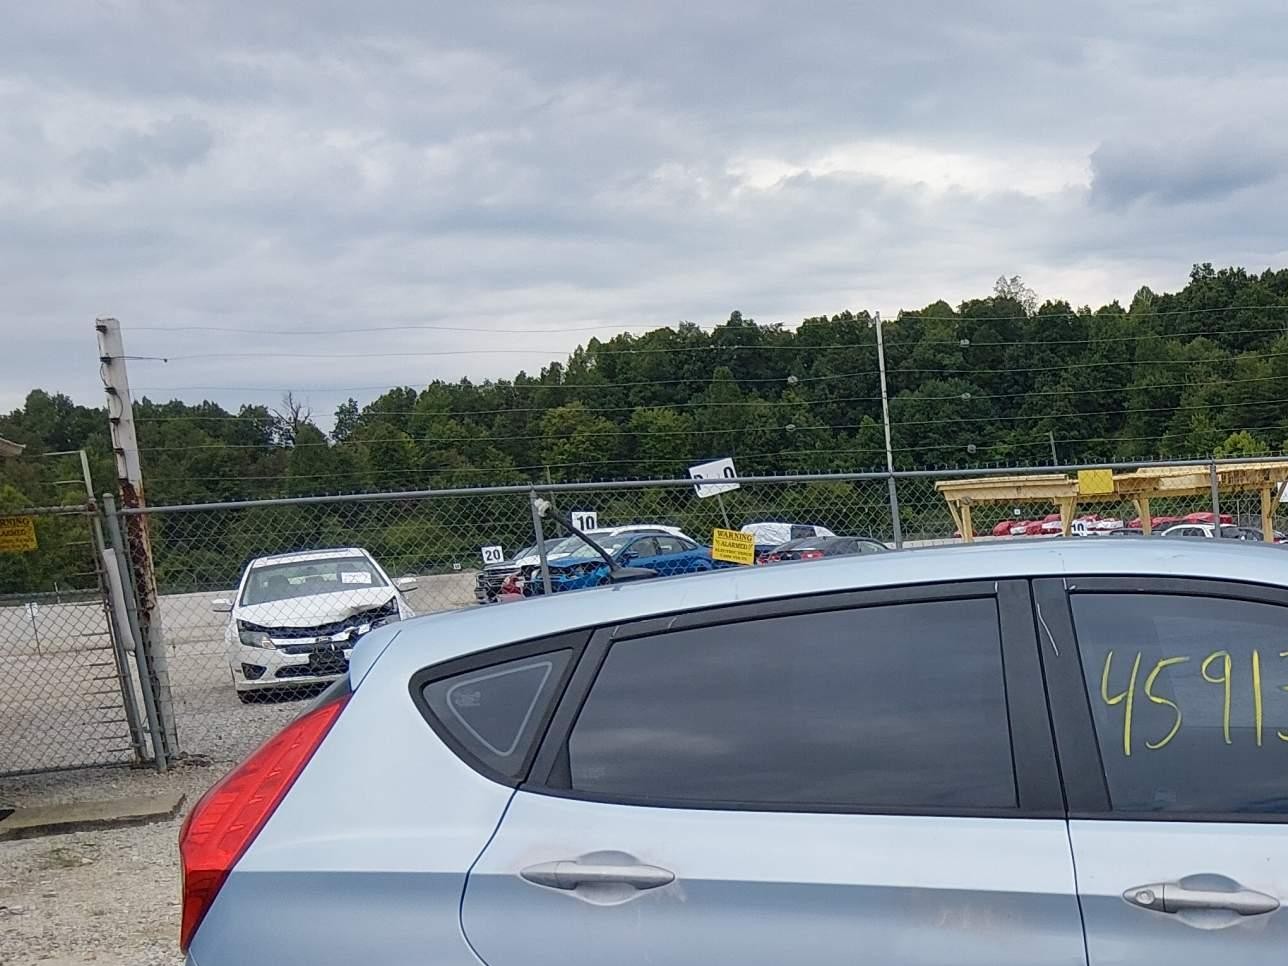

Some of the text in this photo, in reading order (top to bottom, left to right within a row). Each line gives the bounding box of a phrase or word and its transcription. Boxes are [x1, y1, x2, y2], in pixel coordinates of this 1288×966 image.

[576, 515, 595, 531] 10
[1071, 523, 1084, 532] 10
[717, 530, 753, 542] WARNING
[485, 549, 501, 561] 20
